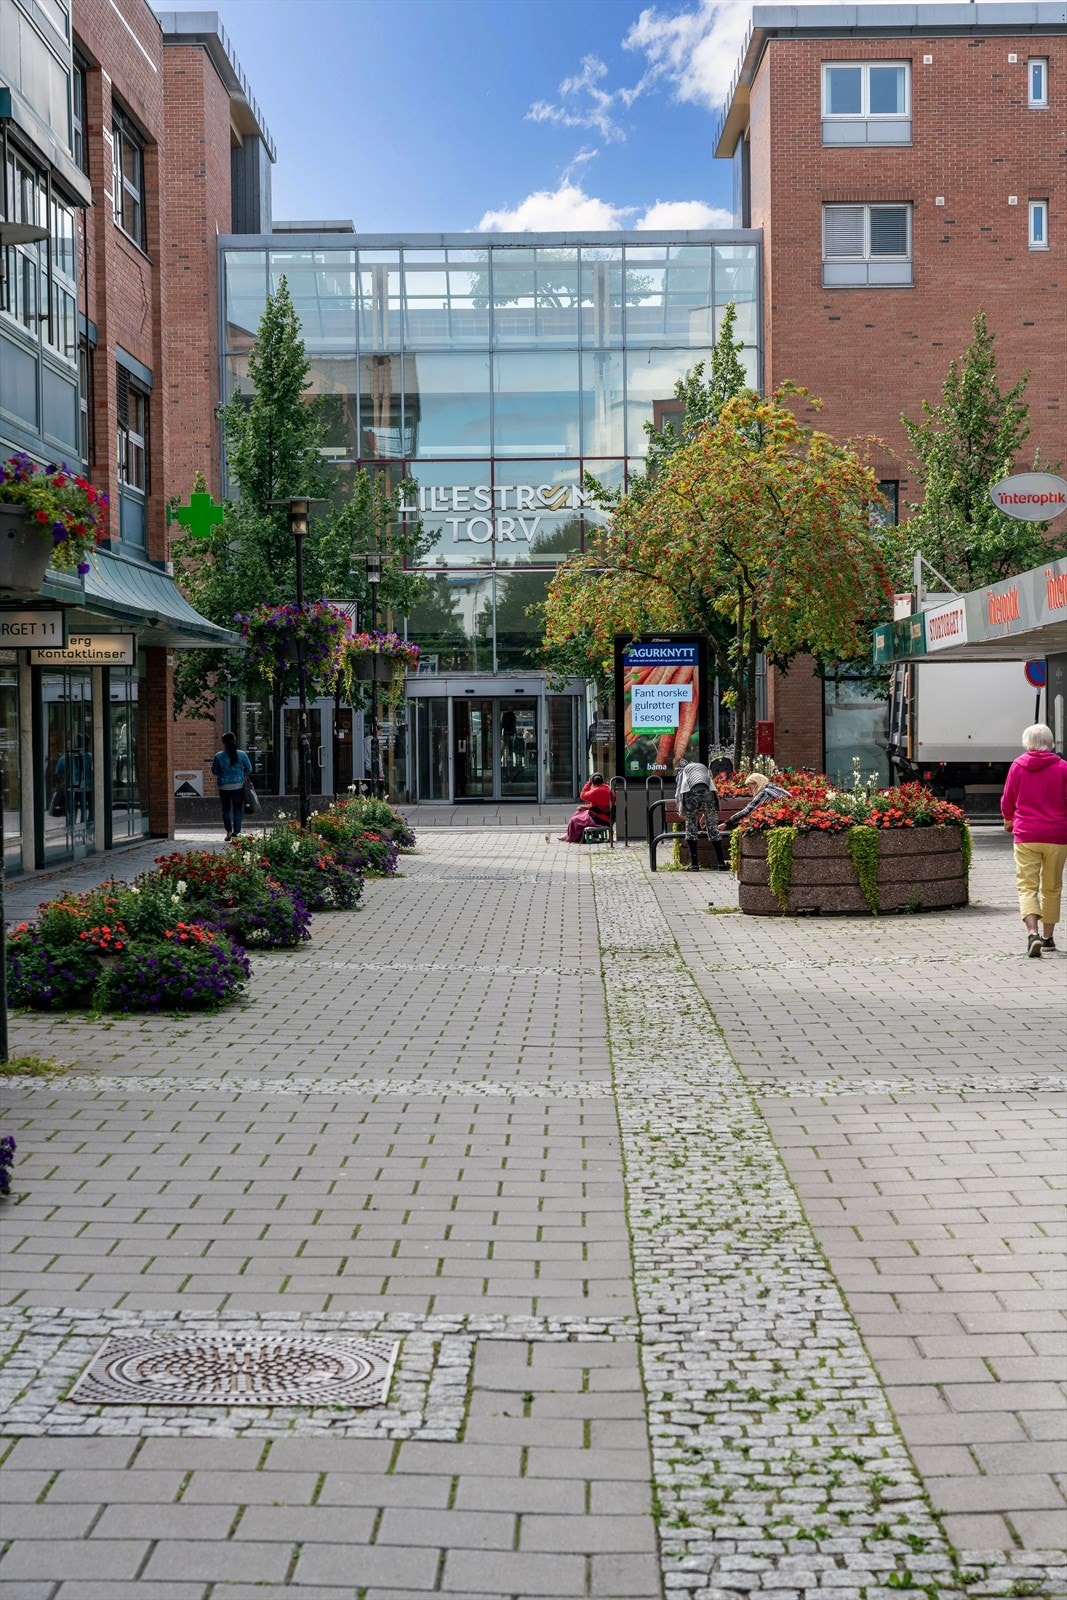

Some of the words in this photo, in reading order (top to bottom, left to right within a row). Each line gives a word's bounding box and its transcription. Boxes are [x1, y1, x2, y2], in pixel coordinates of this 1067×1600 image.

[445, 516, 540, 543] TORV
[0, 623, 37, 635] RGET
[41, 623, 55, 634] 11
[37, 648, 126, 659] Kontaktlinser
[629, 648, 694, 658] AGURKNYTT
[634, 689, 655, 697] Fant
[657, 688, 688, 697] norske
[634, 700, 675, 711] gulrøtter
[640, 713, 673, 723] sesong
